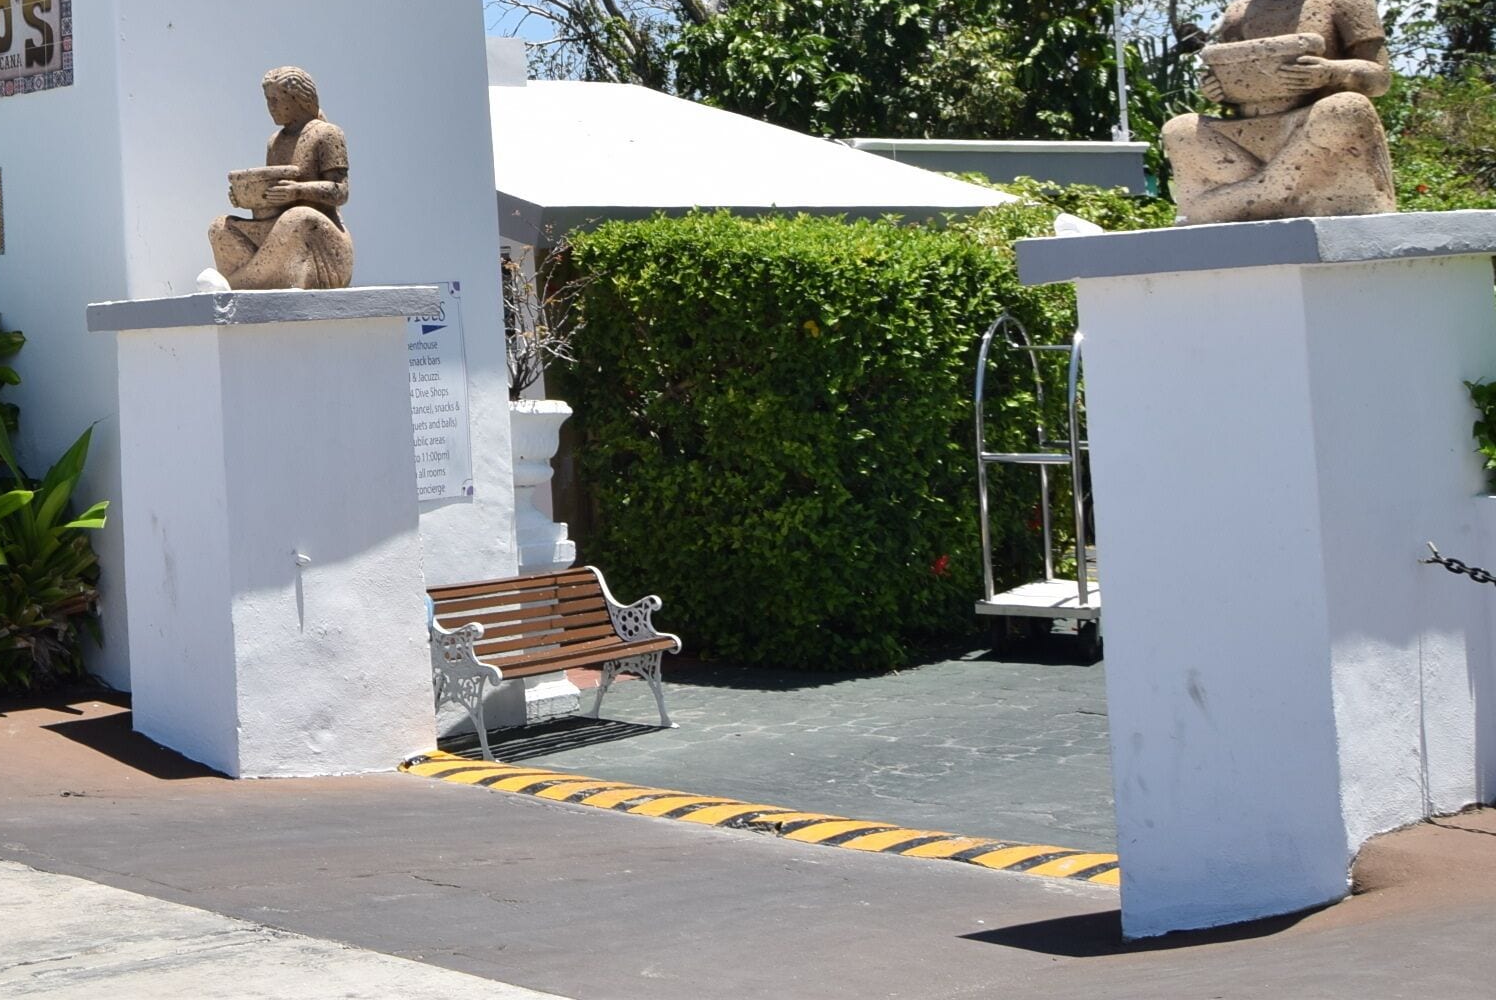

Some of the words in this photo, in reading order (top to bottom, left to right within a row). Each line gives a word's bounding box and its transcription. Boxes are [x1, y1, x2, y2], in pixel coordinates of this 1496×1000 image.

[409, 356, 427, 366] snack
[427, 355, 441, 366] bars
[413, 372, 417, 382] &
[415, 388, 429, 398] Dive
[430, 387, 449, 399] Shops
[434, 401, 454, 413] snacks
[455, 400, 460, 411] &
[429, 420, 440, 429] and
[413, 436, 429, 447] ublic
[429, 436, 446, 446] areas
[418, 468, 426, 479] all
[426, 468, 446, 478] rooms
